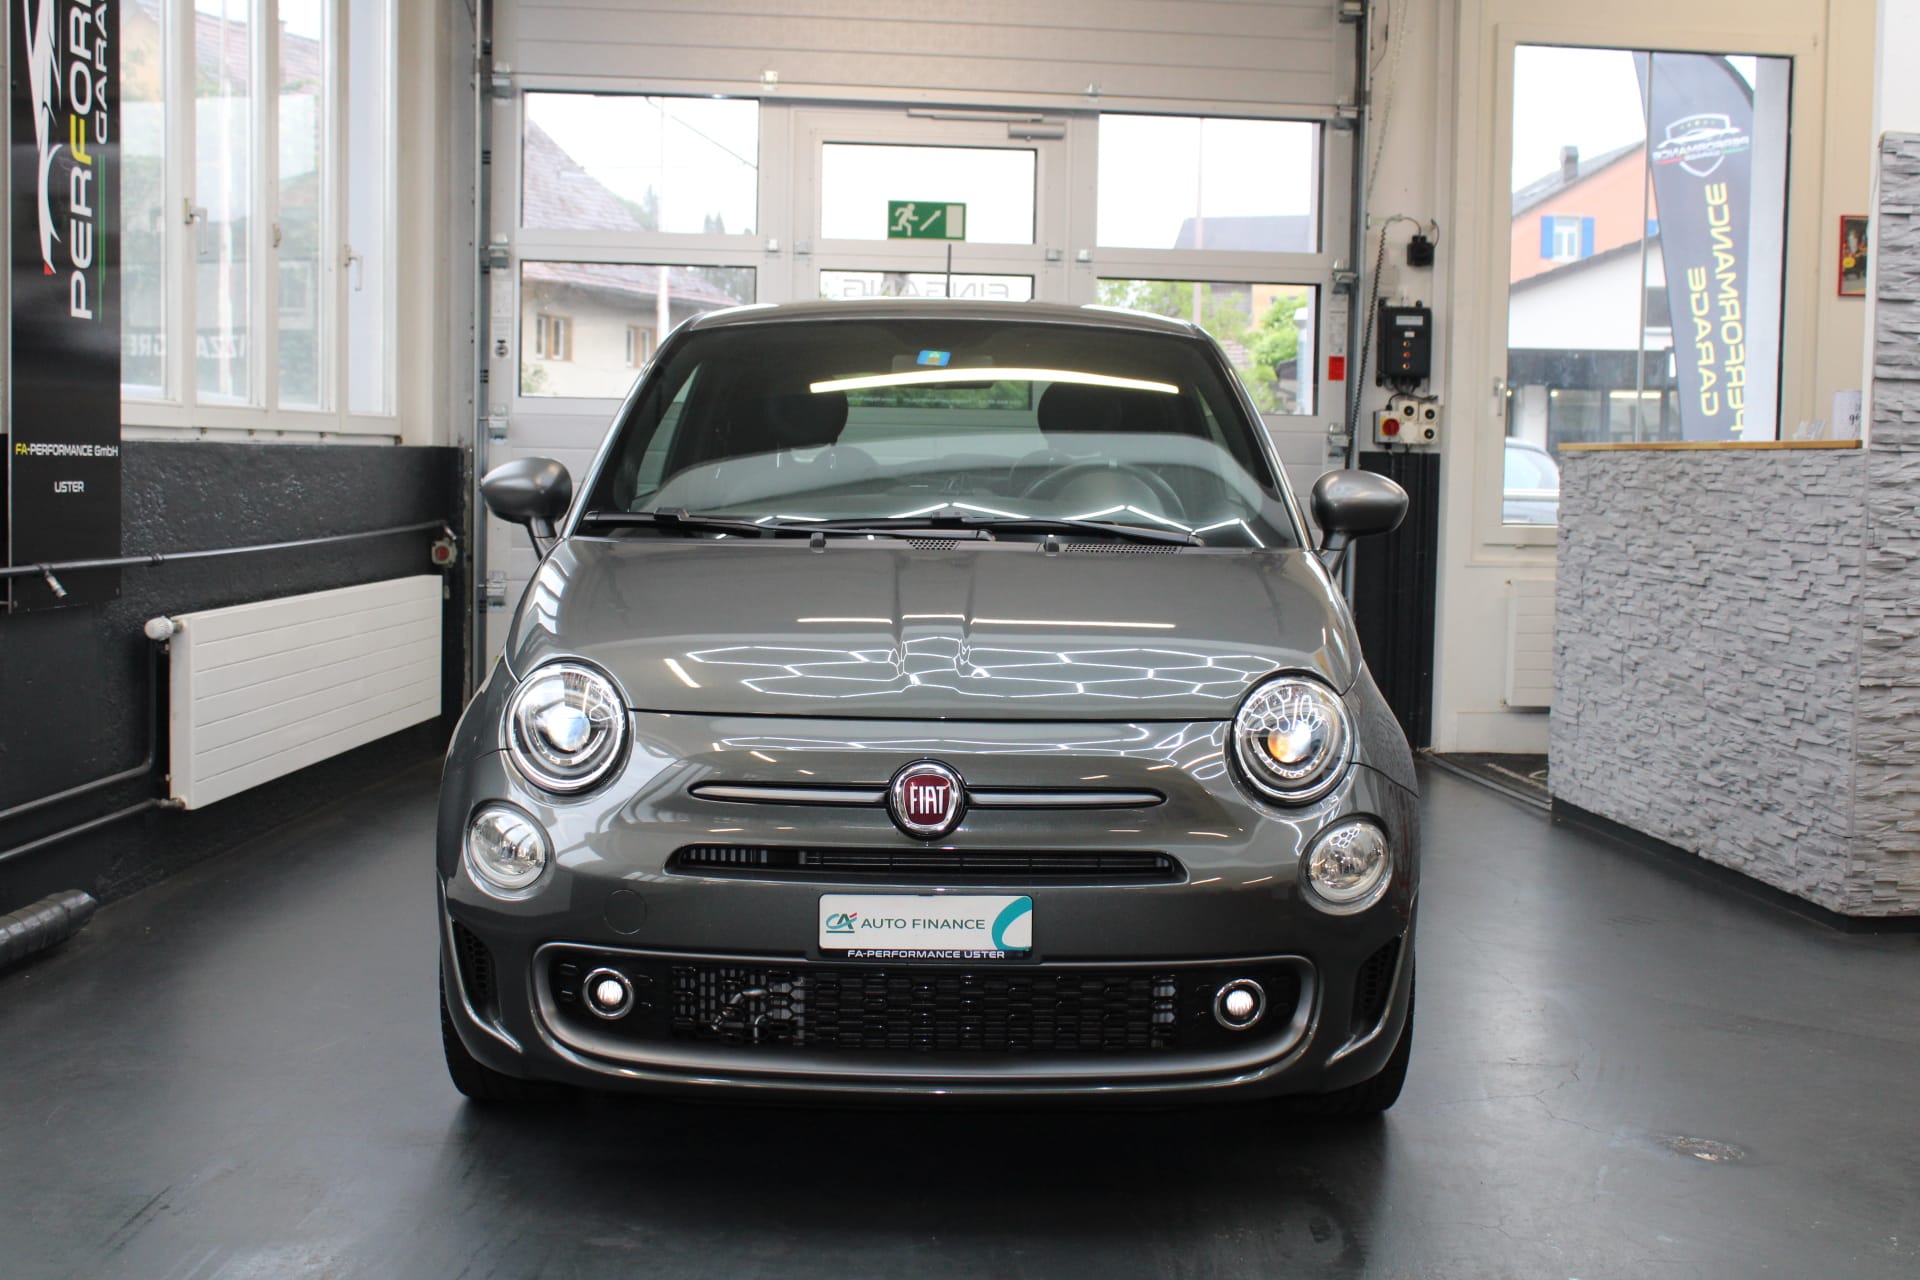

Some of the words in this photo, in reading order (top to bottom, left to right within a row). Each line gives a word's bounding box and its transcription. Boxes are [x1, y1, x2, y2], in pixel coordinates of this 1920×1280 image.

[95, 0, 108, 144] GARA
[70, 0, 92, 319] PERFOR
[15, 443, 93, 456] FA-PERFORMANCE
[94, 445, 119, 457] GmbH
[54, 481, 85, 493] USTER
[909, 785, 946, 815] FIAT
[861, 918, 907, 929] AUTO
[912, 918, 985, 930] FINANCE
[847, 950, 961, 959] FA-PERFORMANCE
[964, 950, 1006, 959] USTER
